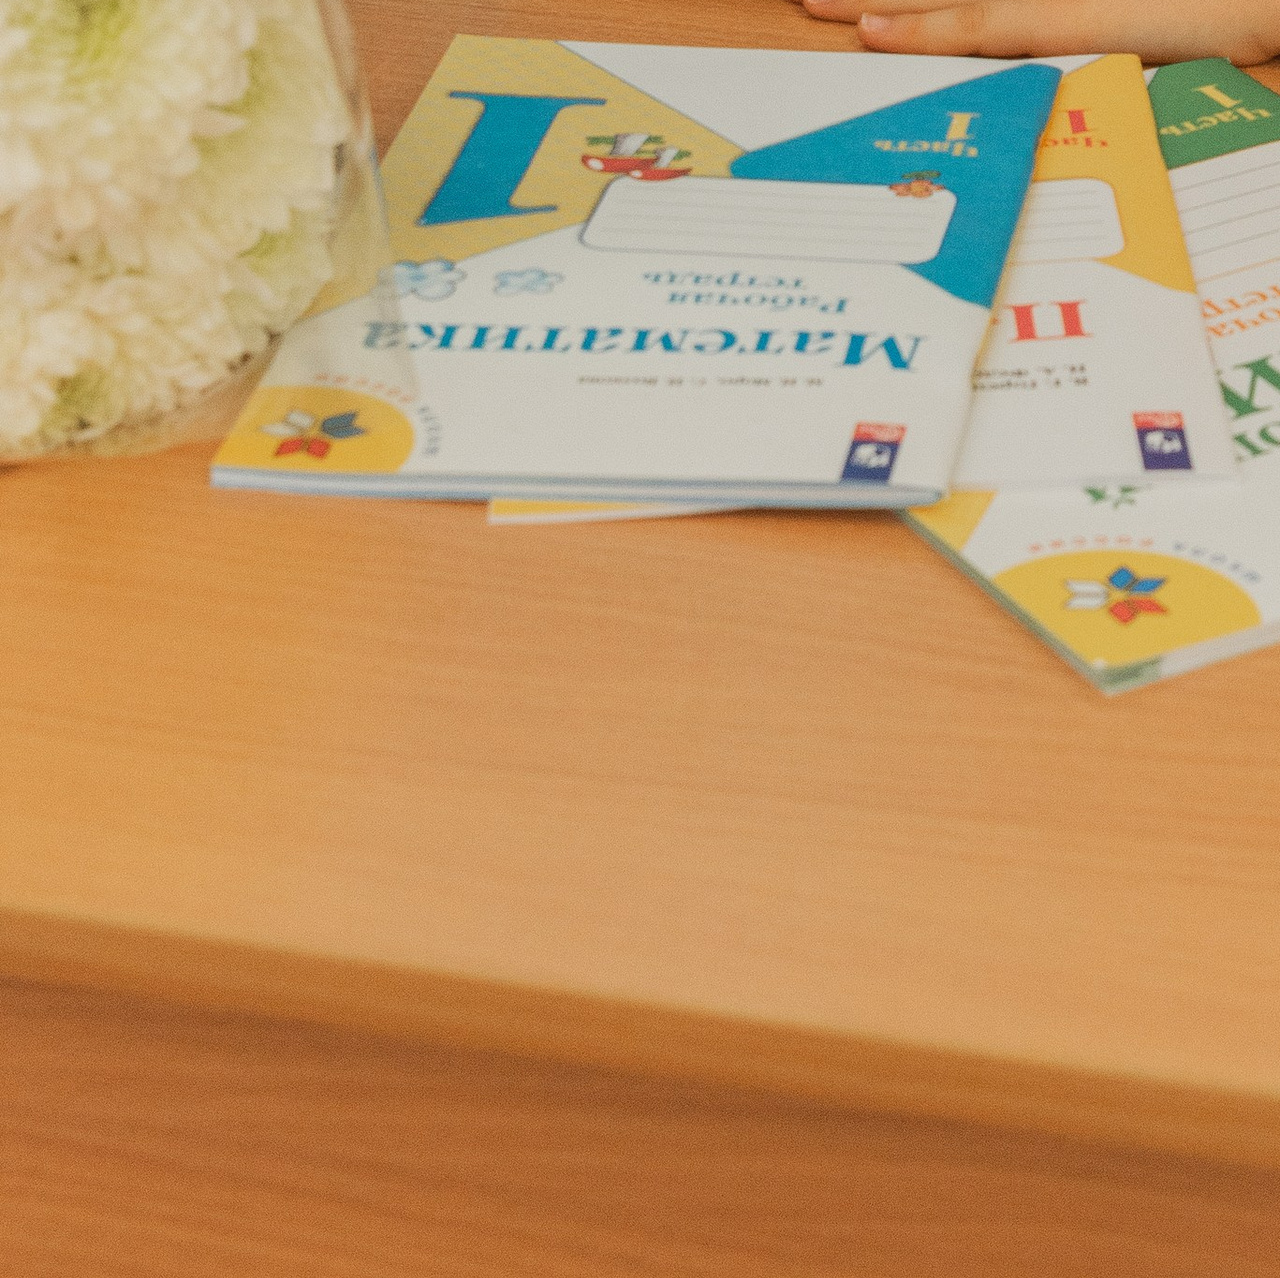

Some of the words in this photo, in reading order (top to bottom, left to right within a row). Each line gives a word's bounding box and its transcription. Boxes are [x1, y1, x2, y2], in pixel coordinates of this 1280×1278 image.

[1192, 83, 1241, 109] 1
[945, 112, 980, 140] 1
[873, 140, 979, 158] Часть
[1041, 136, 1108, 149] Час
[416, 90, 608, 226] 1
[641, 271, 810, 291] тетрадь
[666, 292, 849, 315] Рабочая
[989, 298, 1093, 344] П
[362, 323, 928, 373] Математика
